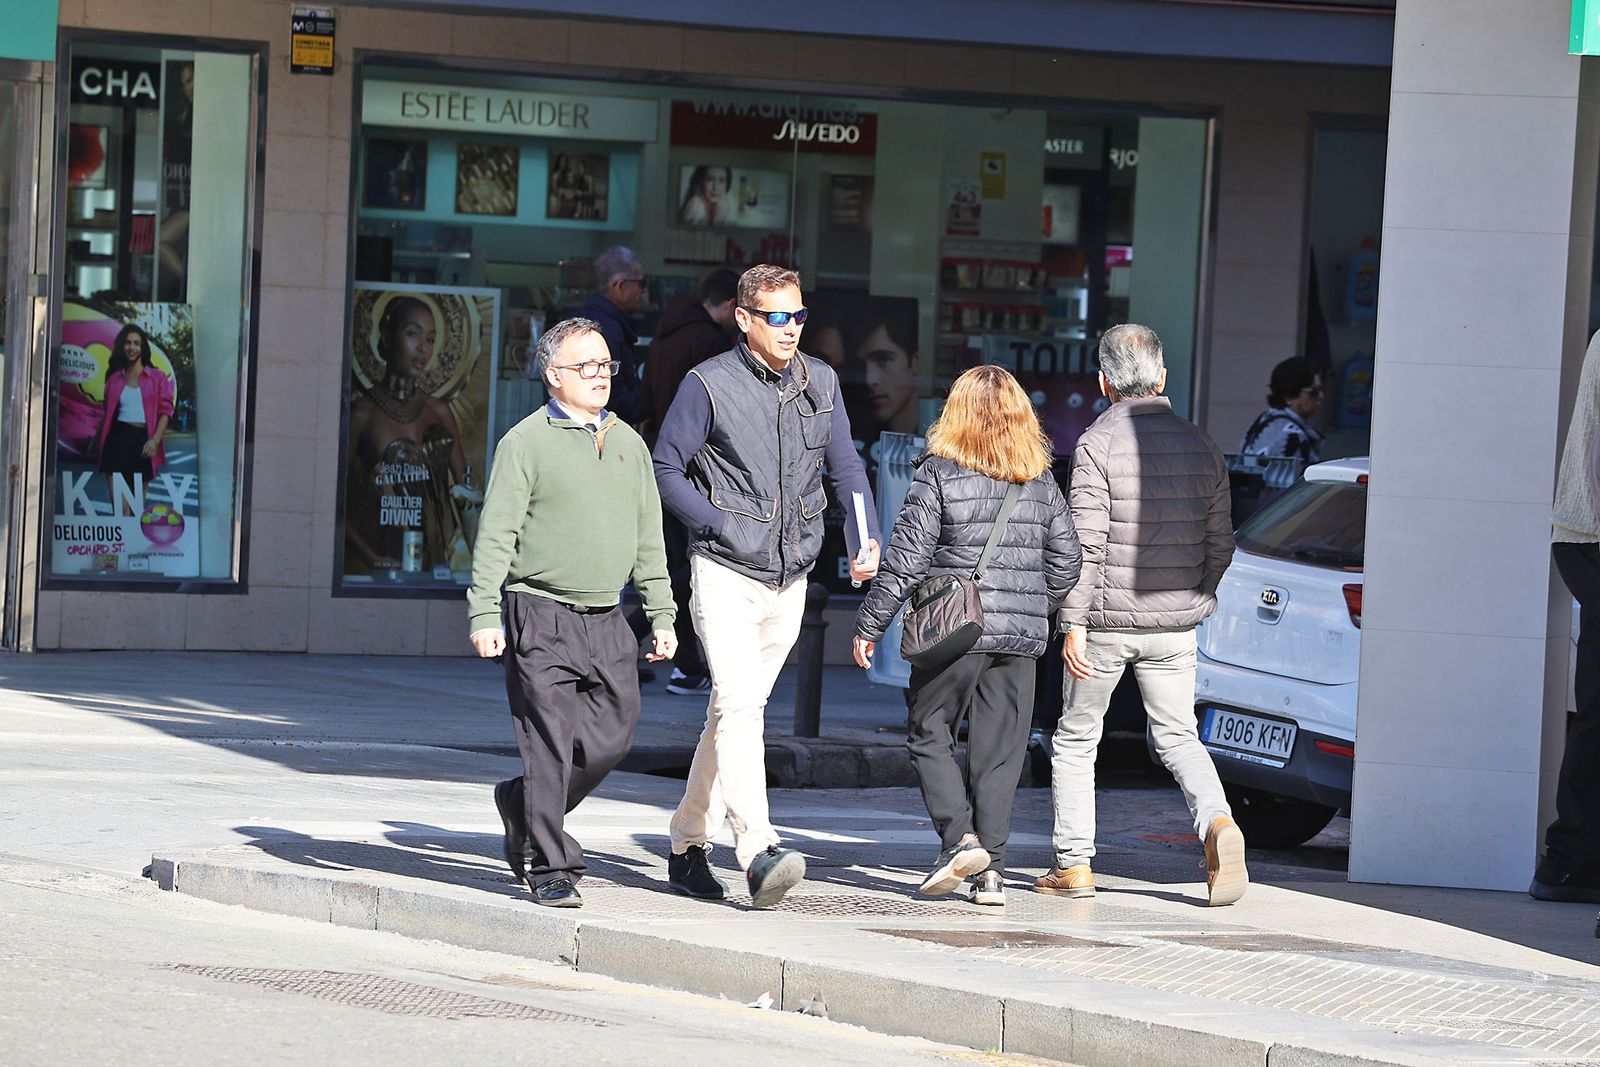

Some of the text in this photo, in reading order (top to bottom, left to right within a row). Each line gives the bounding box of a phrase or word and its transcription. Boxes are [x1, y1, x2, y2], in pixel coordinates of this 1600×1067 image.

[79, 67, 157, 100] CHA
[486, 97, 590, 129] LAUDER
[772, 119, 860, 144] SHISEIDO
[1043, 139, 1084, 154] ASTER
[60, 358, 95, 371] DELICIOUS
[375, 469, 430, 485] GAULTIER
[381, 496, 422, 508] GAULTIER
[381, 509, 421, 526] DIVINE
[54, 524, 123, 541] DELICIOUS
[67, 543, 126, 556] ORCHARD ST.
[1262, 589, 1277, 603] KIA
[1216, 714, 1292, 753] 1906 KFN
